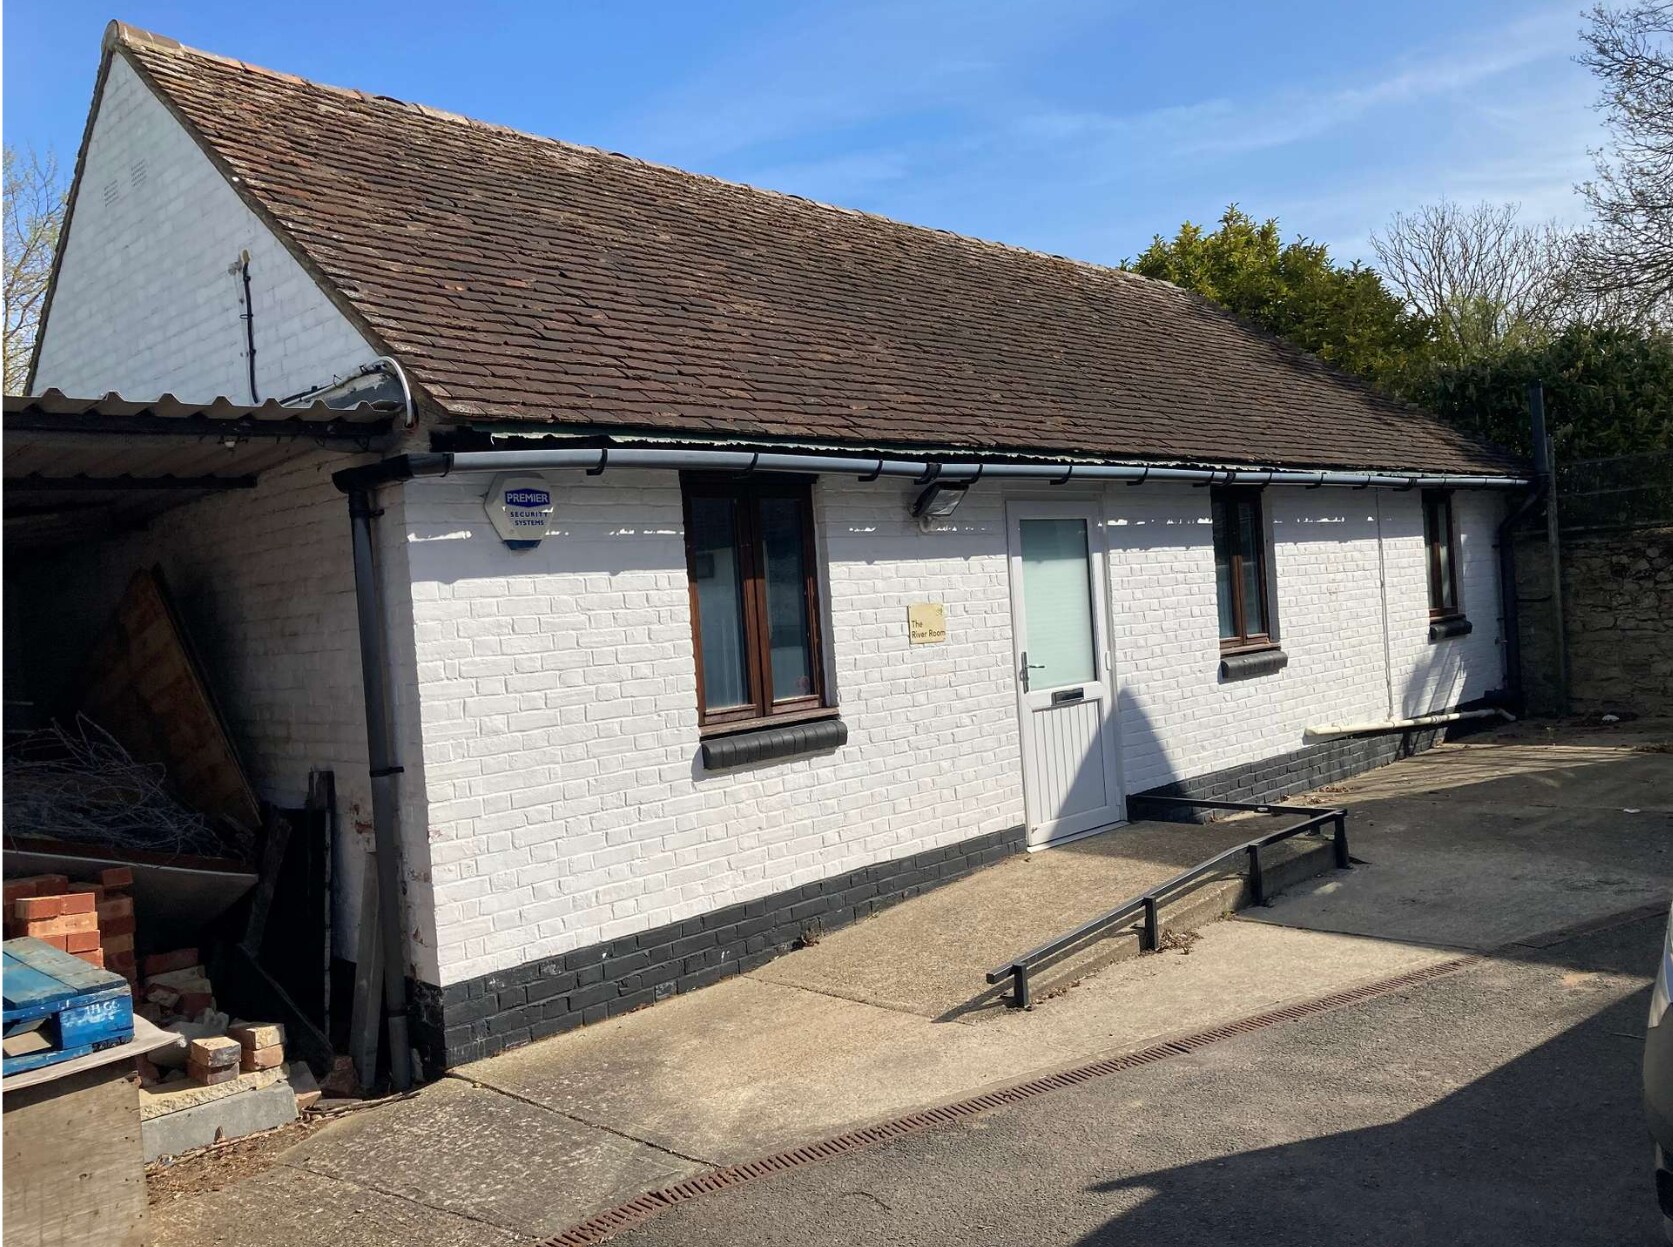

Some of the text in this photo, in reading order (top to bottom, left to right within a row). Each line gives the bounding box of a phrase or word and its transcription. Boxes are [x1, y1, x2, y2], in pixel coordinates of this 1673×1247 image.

[507, 493, 548, 503] PREMIER
[912, 620, 923, 628] The
[912, 629, 946, 638] River Room
